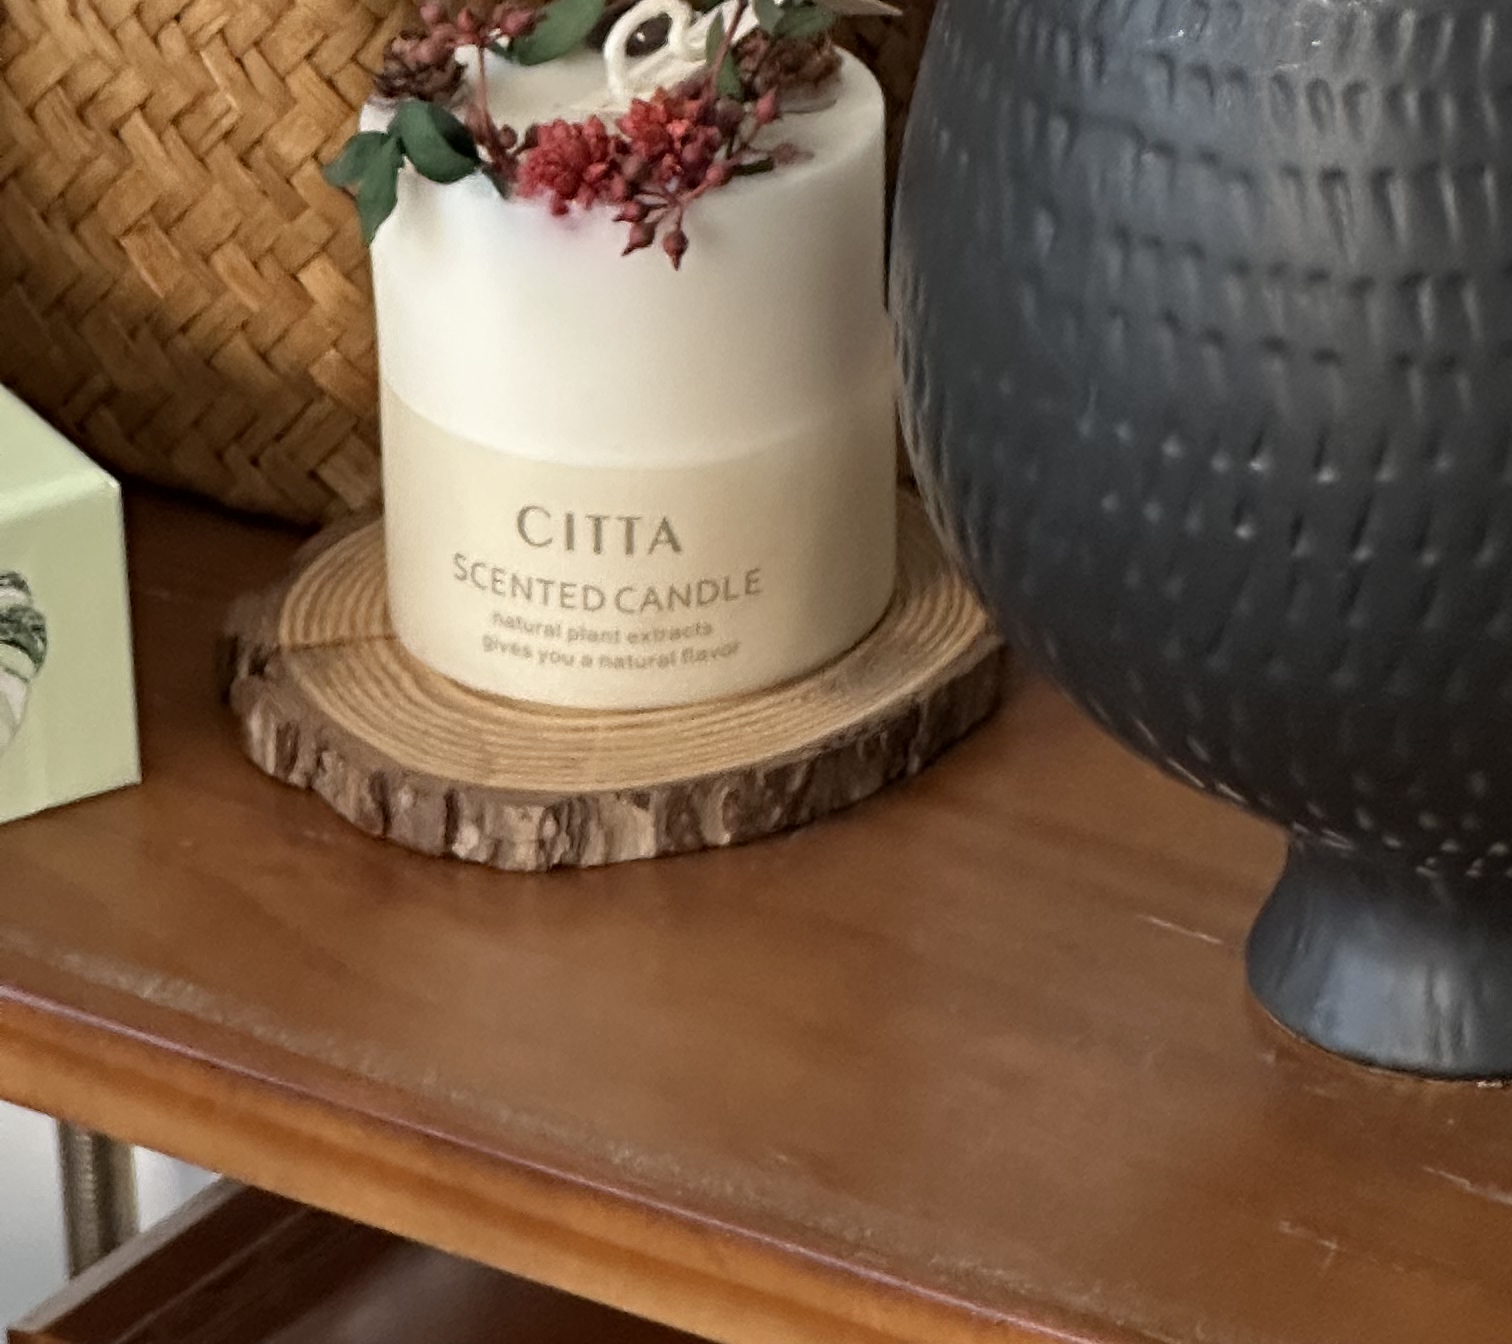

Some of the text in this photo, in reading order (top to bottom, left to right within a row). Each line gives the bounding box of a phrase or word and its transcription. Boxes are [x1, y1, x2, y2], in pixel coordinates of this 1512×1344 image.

[516, 504, 683, 556] CITTA
[452, 551, 764, 614] SCENTED CANDLE
[492, 613, 562, 639] natural
[537, 649, 575, 667] you
